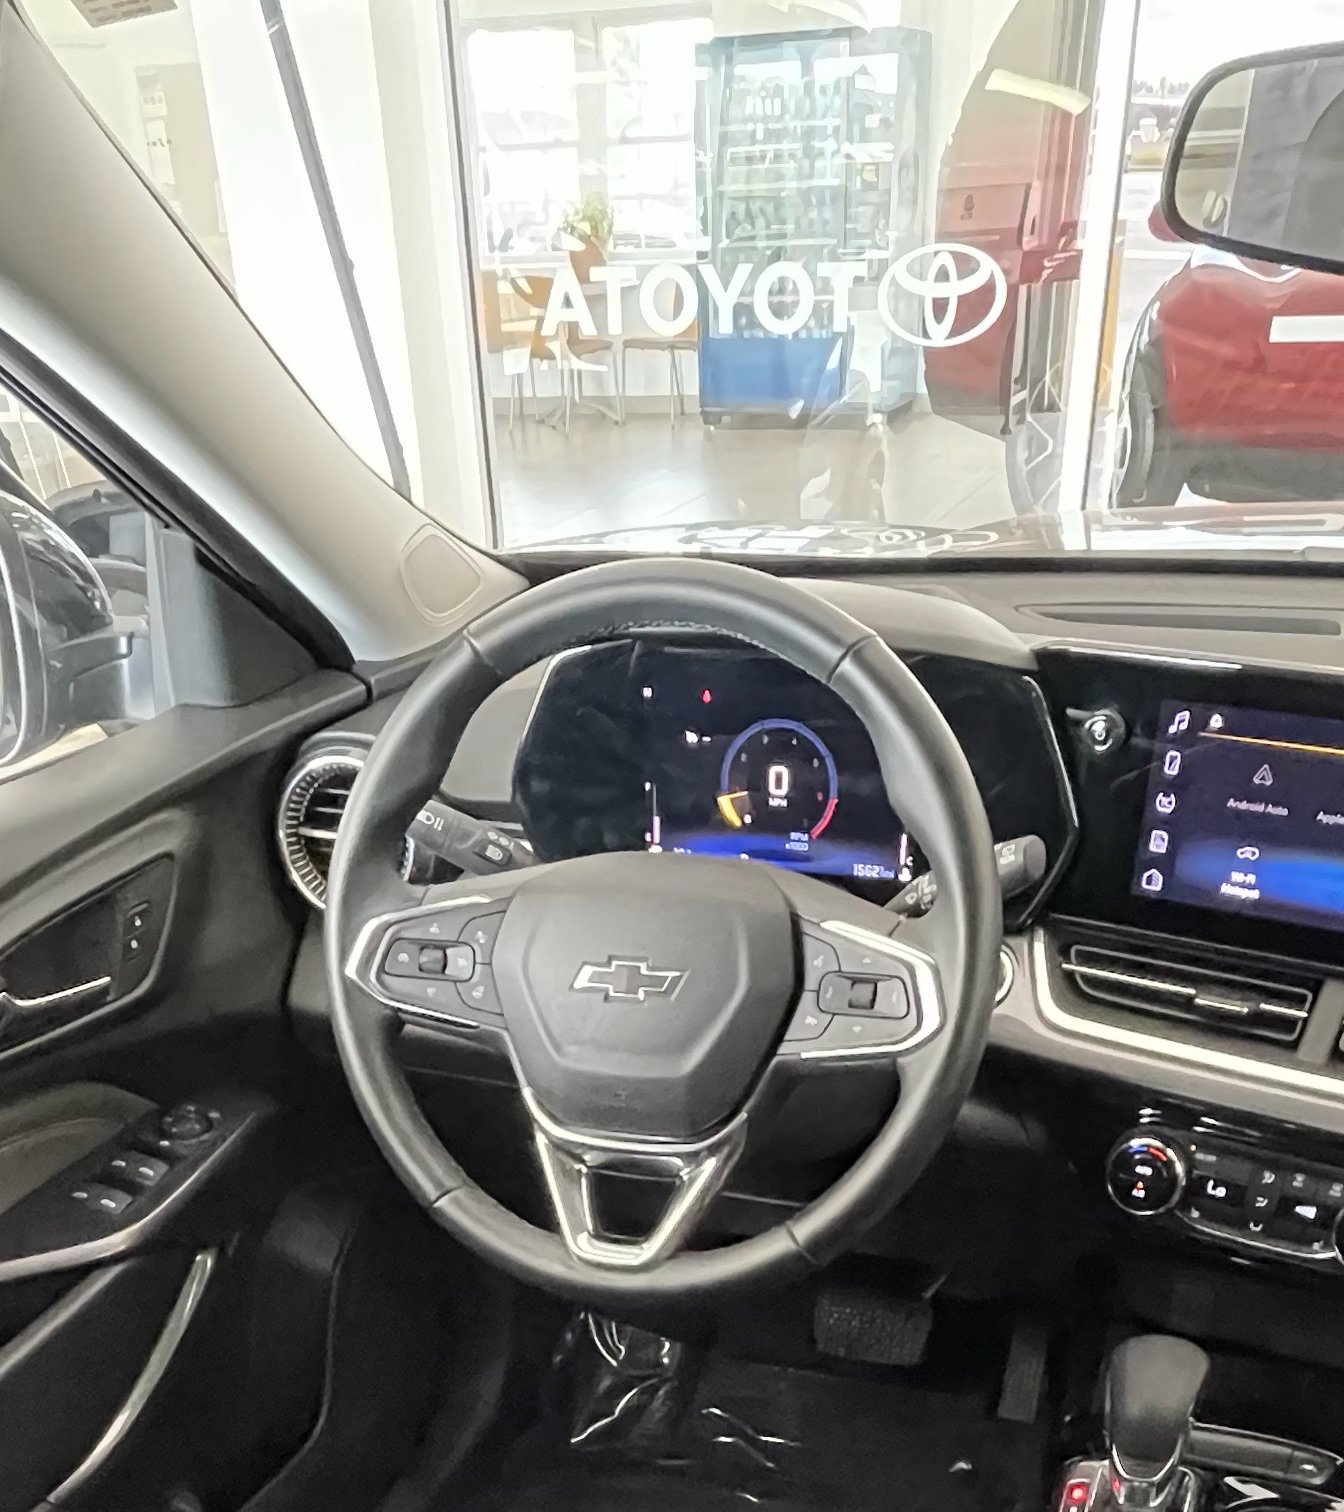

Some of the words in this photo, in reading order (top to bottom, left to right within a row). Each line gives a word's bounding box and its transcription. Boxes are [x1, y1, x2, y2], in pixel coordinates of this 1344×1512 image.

[768, 765, 789, 796] 0
[1226, 798, 1265, 813] Android
[1265, 803, 1289, 816] Auto
